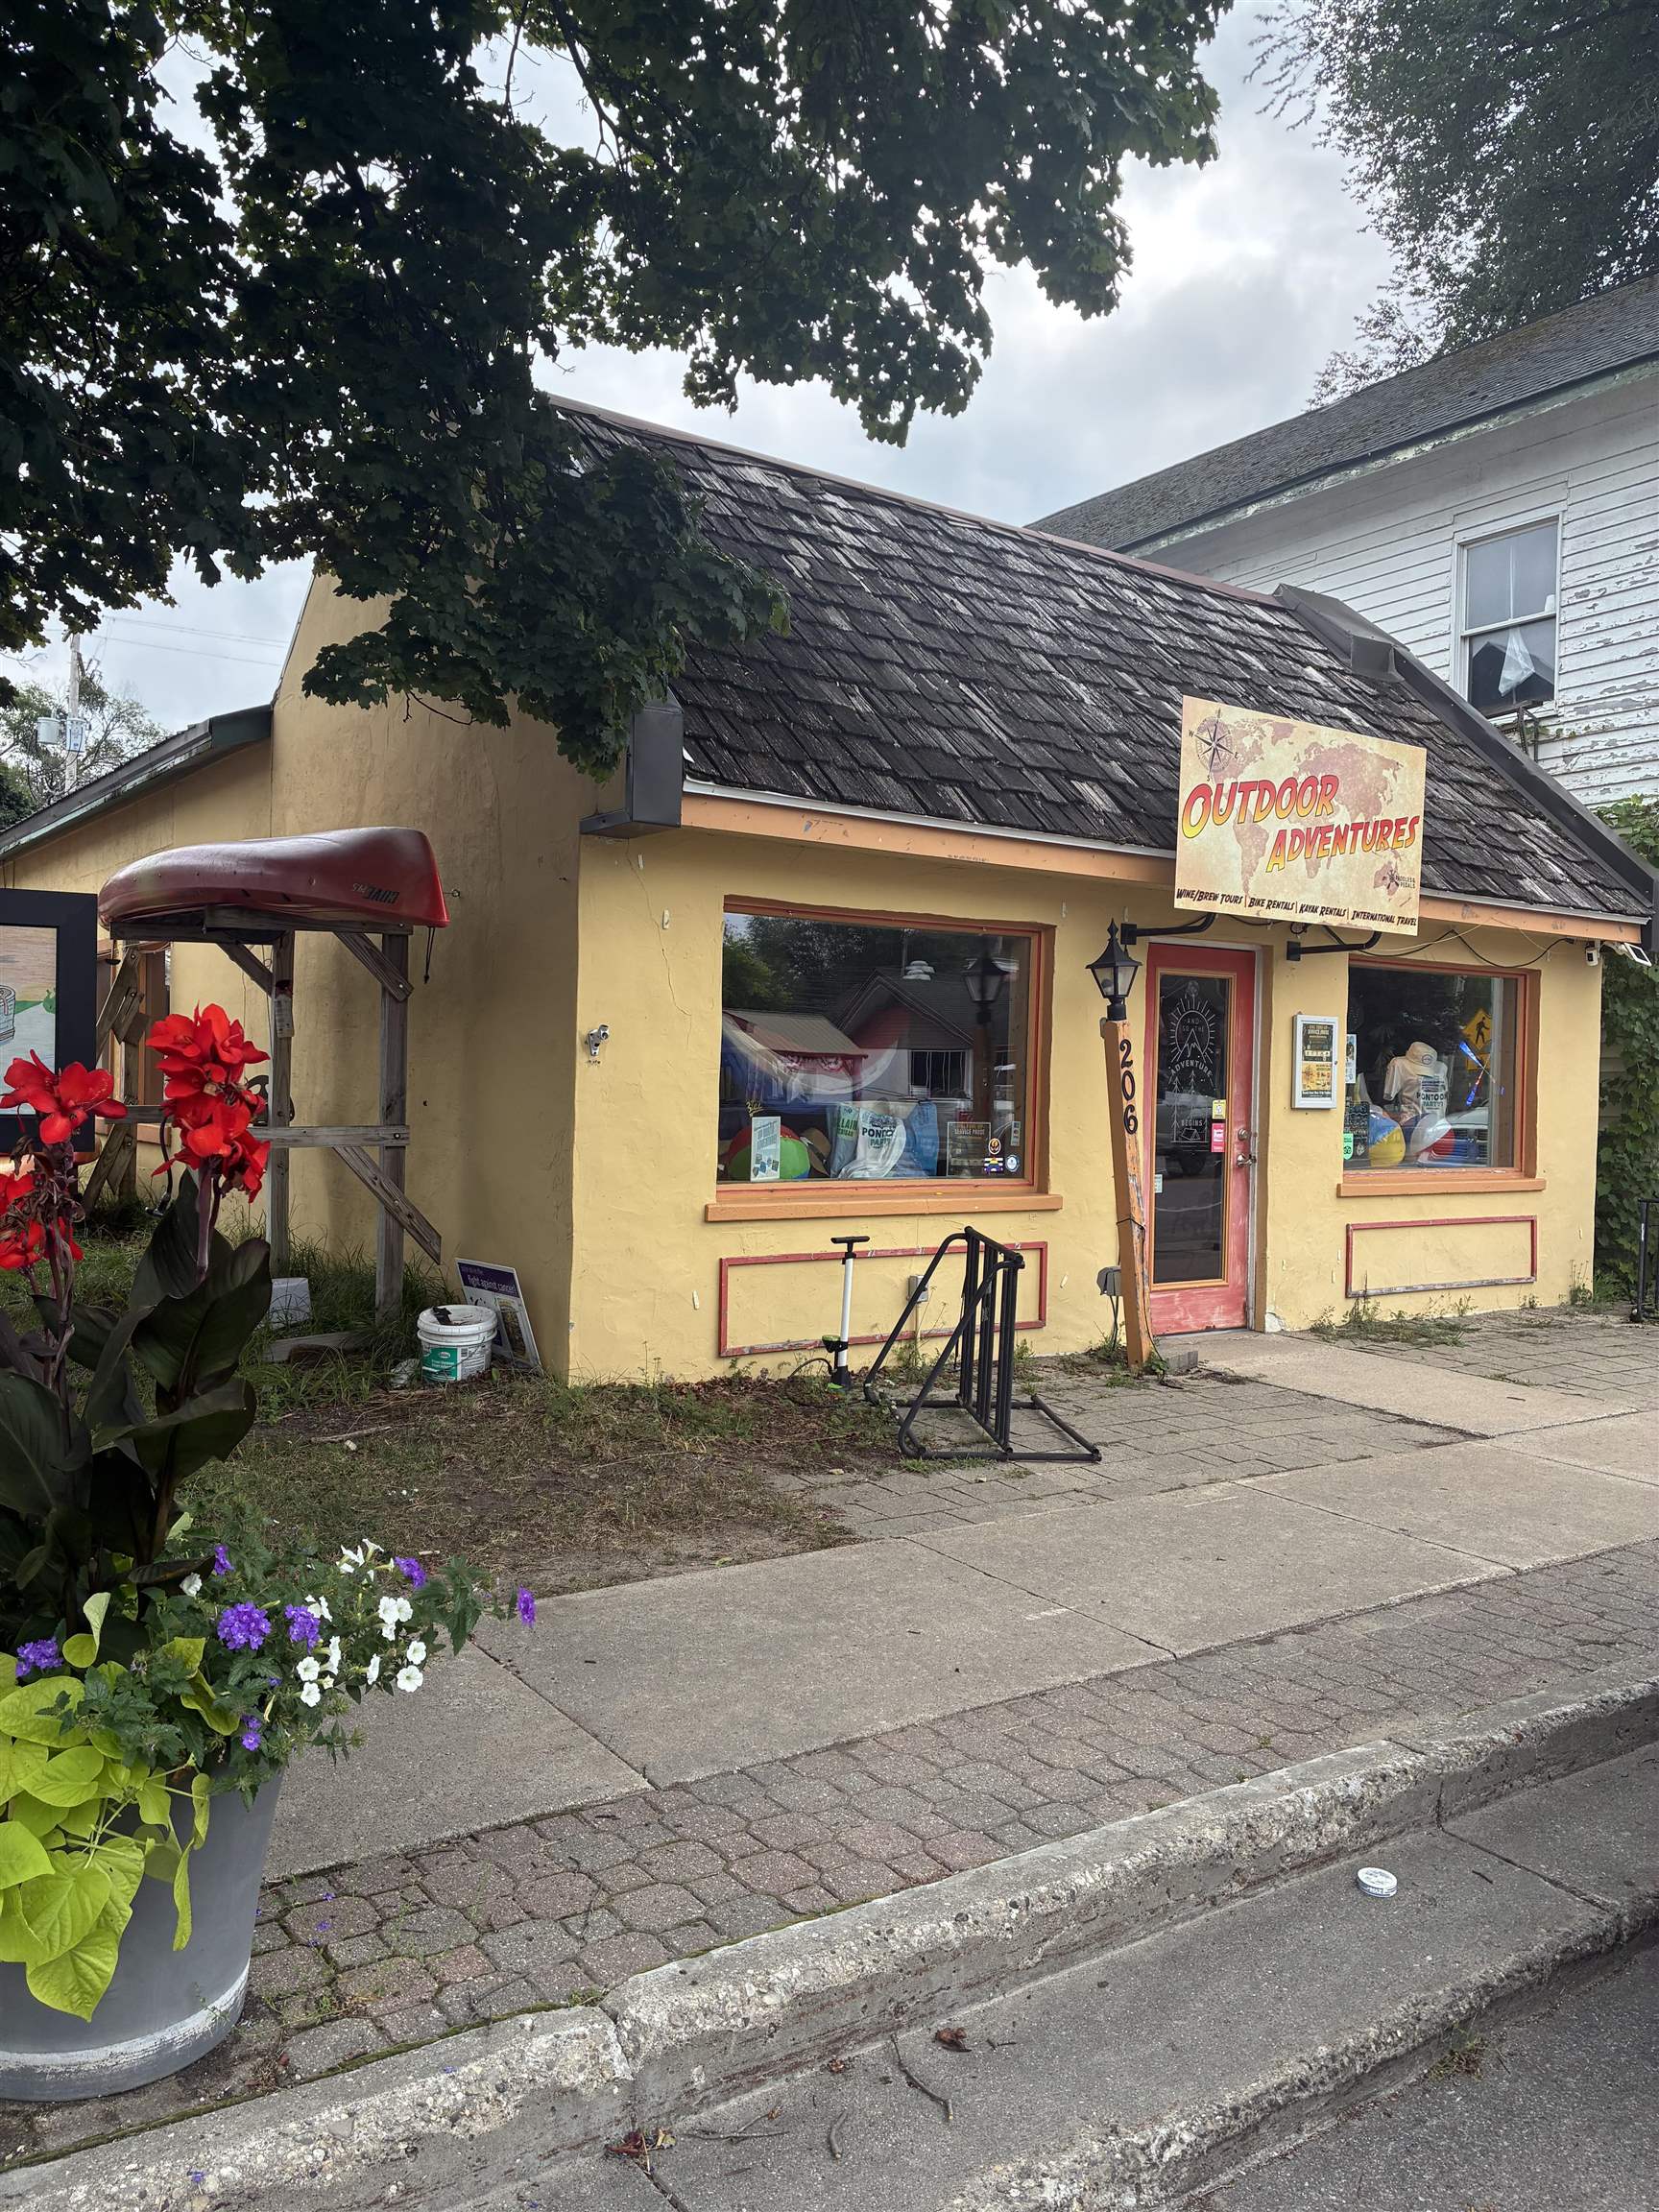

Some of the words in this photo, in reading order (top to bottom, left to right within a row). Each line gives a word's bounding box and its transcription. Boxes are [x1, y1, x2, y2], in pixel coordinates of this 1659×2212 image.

[1181, 774, 1340, 839] OUTDOOR
[1265, 815, 1421, 874] ADVENTURES
[1176, 888, 1219, 902] WINE/BREW
[1220, 893, 1243, 904] TOURS
[1248, 898, 1266, 907] BIKE
[1265, 900, 1295, 911] RENTALS
[1299, 903, 1318, 914] KAYAK
[1319, 906, 1347, 916] RENTALS
[1351, 910, 1396, 924] INTERNATIONAL
[1397, 916, 1417, 926] TRAVEL
[1119, 1038, 1139, 1135] 206
[1170, 1059, 1213, 1077] ADVENTURE
[861, 1126, 895, 1139] PONTO
